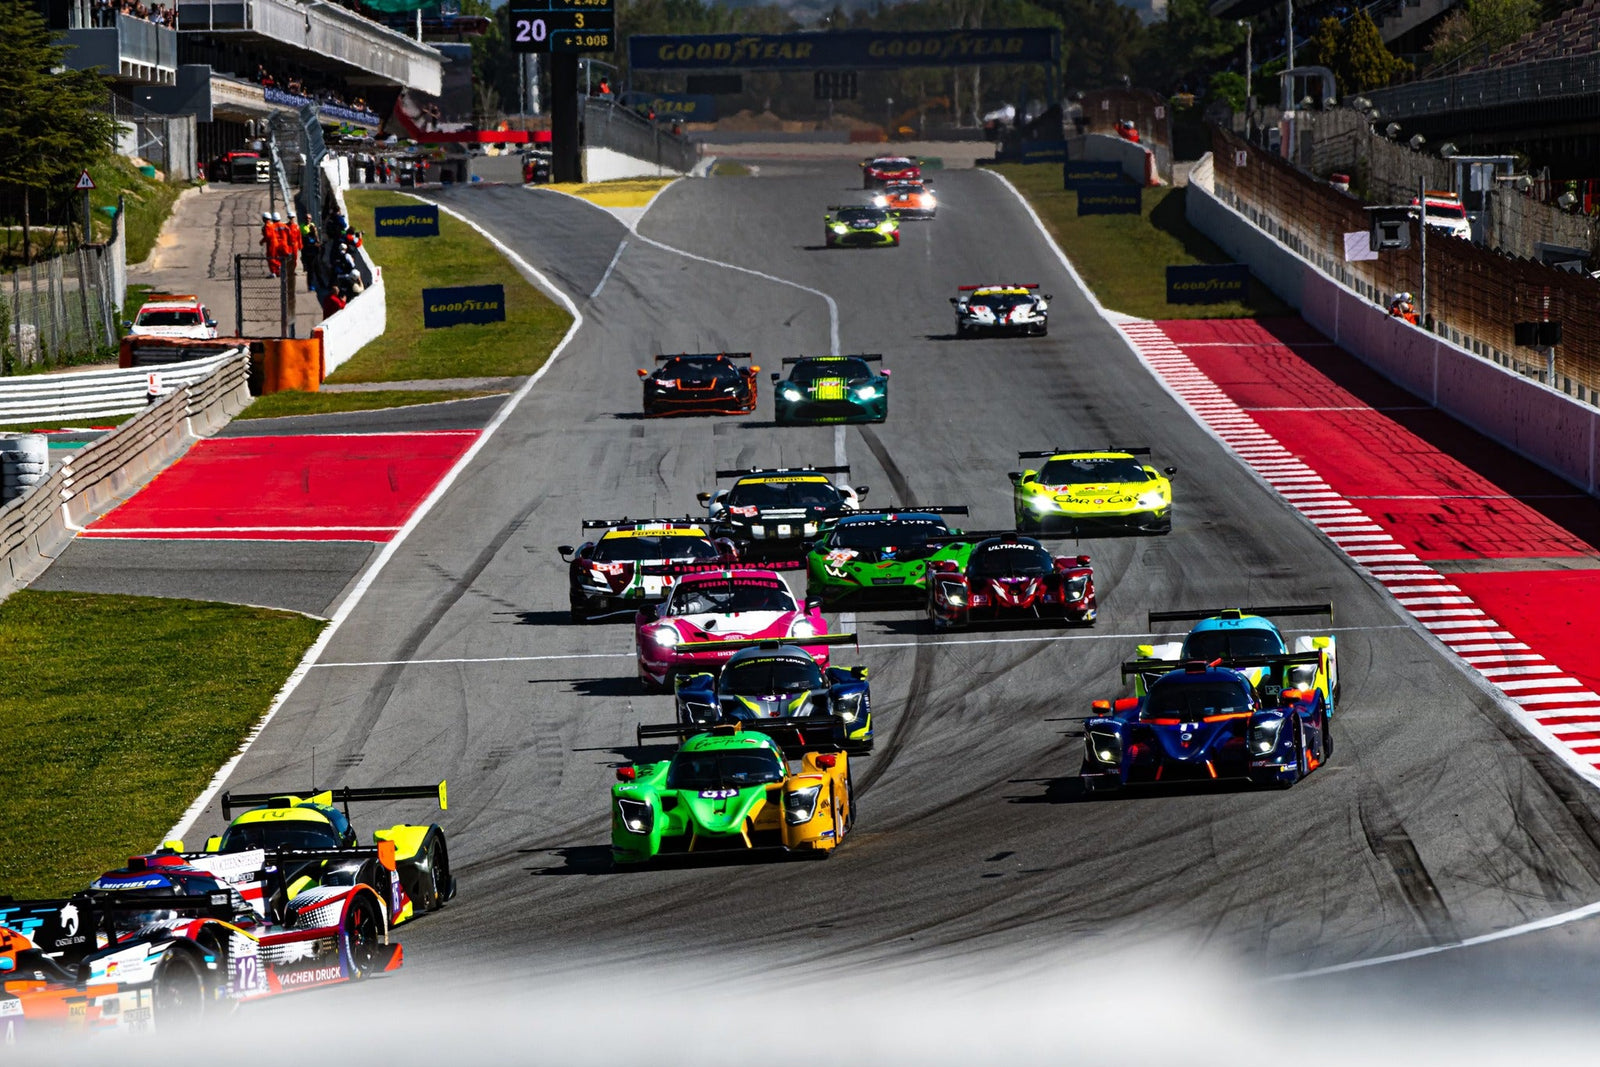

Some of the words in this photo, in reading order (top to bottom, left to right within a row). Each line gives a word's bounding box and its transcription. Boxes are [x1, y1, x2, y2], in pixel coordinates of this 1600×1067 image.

[575, 12, 585, 28] 3
[515, 19, 547, 42] 20
[658, 38, 813, 62] GOODYEAR
[868, 34, 1024, 58] GOODYEAR
[380, 215, 434, 227] GOODYEAR
[1172, 278, 1242, 292] GOODYEAR
[429, 299, 499, 313] GOODYEAR
[987, 543, 1035, 552] ULTIMATE
[699, 580, 729, 588] IRON
[733, 579, 779, 589] DAMES
[102, 879, 162, 889] MICHELIN
[238, 956, 257, 990] 12
[315, 966, 341, 981] DRUCK
